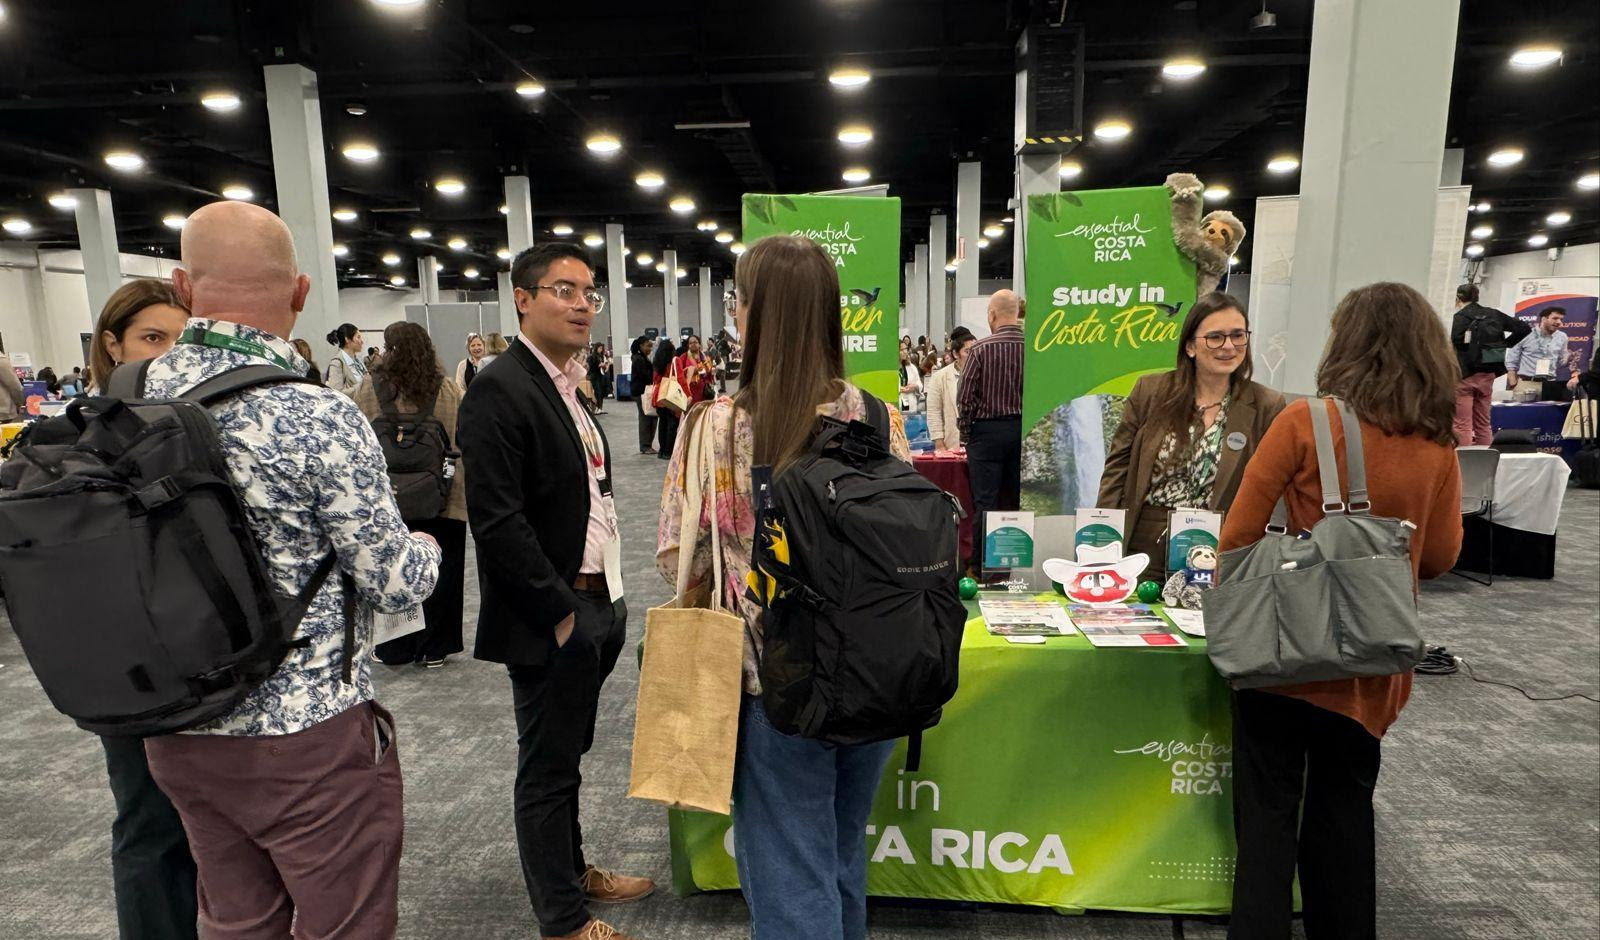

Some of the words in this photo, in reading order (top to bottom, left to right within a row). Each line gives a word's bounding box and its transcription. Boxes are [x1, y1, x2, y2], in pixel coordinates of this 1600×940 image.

[1054, 213, 1157, 240] essential
[820, 242, 857, 255] OSTA
[1094, 235, 1146, 249] COSTA
[1094, 248, 1131, 262] RICA
[1052, 283, 1133, 307] Study
[1139, 282, 1165, 303] in
[1034, 308, 1107, 352] Costa
[1110, 305, 1178, 349] Rica
[1113, 733, 1231, 762] essentia
[1171, 760, 1232, 778] COST
[897, 769, 940, 812] in
[1171, 778, 1223, 795] RICA
[931, 828, 1075, 875] RICA
